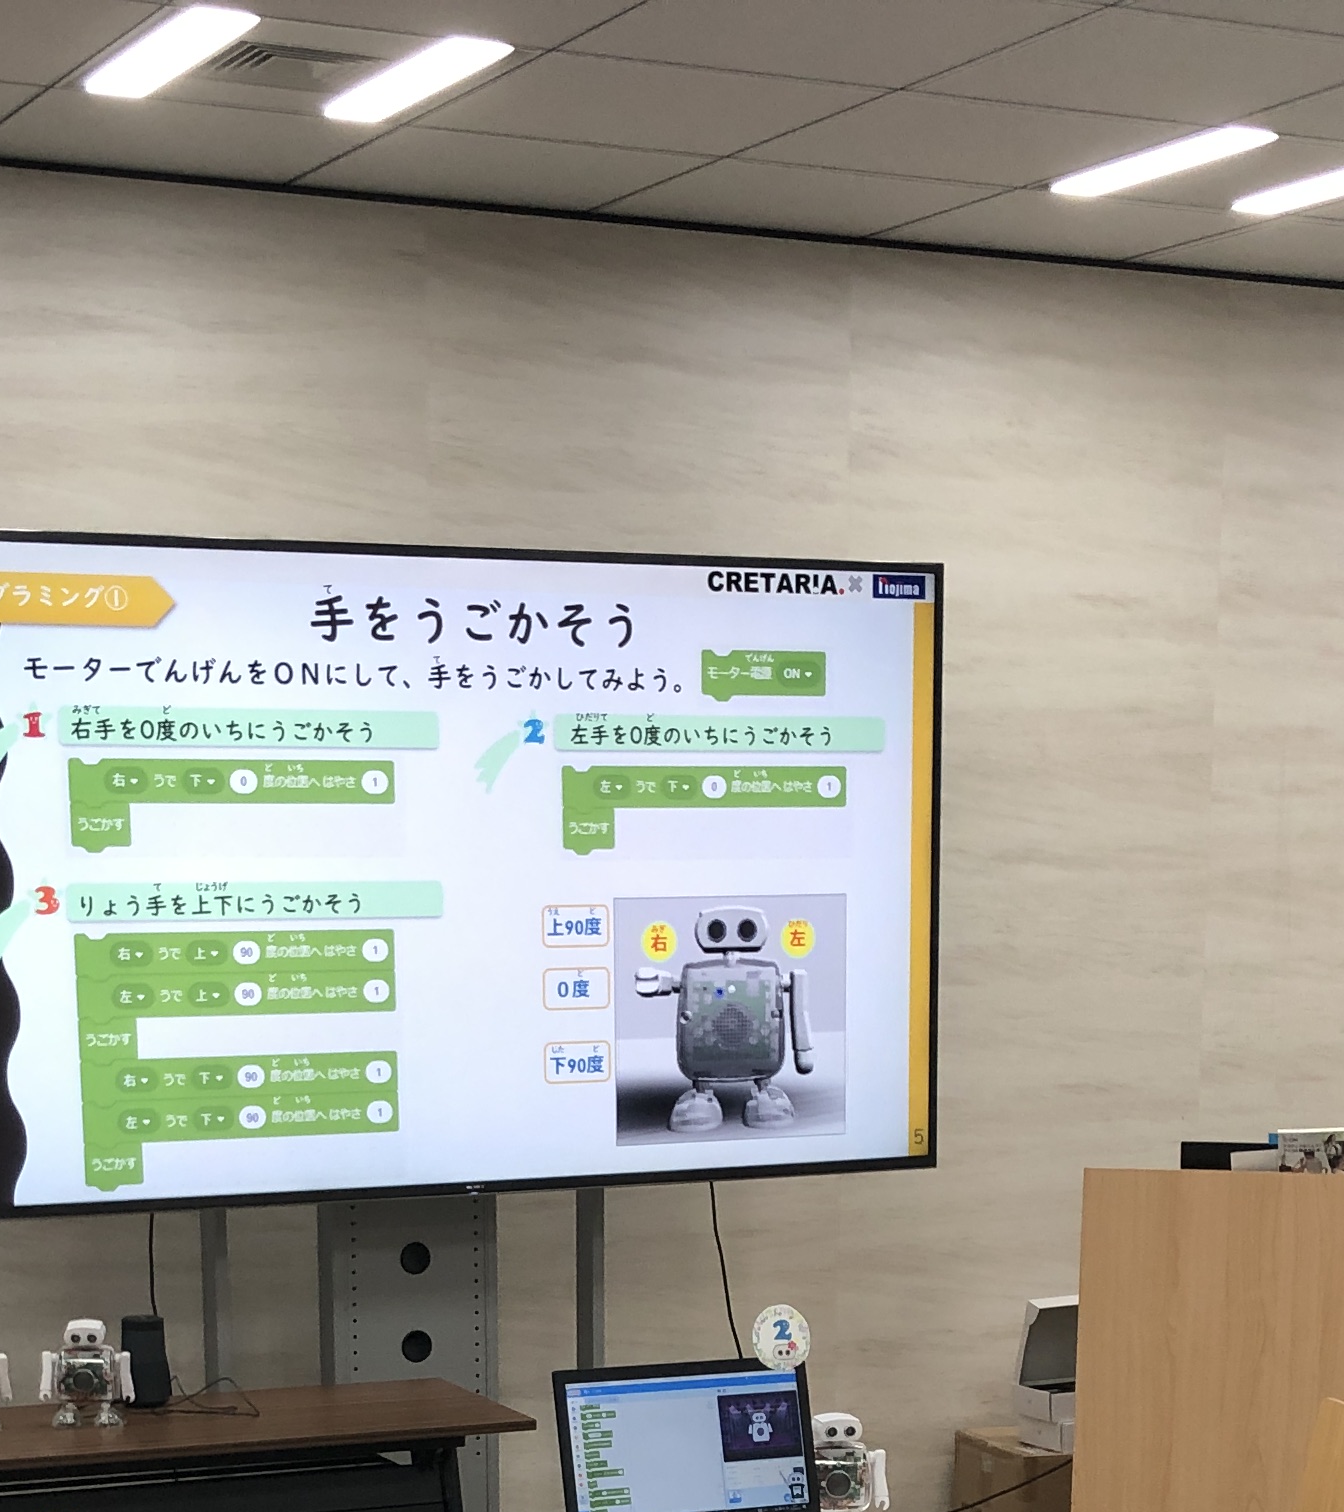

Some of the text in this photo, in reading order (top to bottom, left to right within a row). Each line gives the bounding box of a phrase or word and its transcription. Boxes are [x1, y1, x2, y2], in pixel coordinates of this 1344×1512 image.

[311, 595, 634, 648] 手をうごかそう
[783, 668, 801, 678] ON
[524, 719, 545, 745] 2
[112, 774, 125, 787] 右
[154, 775, 176, 787] うで
[190, 775, 201, 787] 下
[240, 777, 247, 786] 0
[600, 781, 611, 792] 左
[636, 782, 656, 792] うで
[668, 782, 677, 792] 下
[711, 783, 717, 791] 0
[34, 885, 60, 915] 3
[80, 894, 362, 917] りょう手を上下にうごかそう
[547, 918, 602, 936] 上90度
[651, 934, 667, 952] 右
[790, 929, 806, 947] 左
[118, 948, 131, 960] 右
[159, 948, 181, 960] うで
[194, 948, 206, 960] 上
[240, 948, 253, 957] 90
[120, 990, 132, 1003] 左
[161, 990, 182, 1002] うで
[196, 990, 208, 1001] 上
[242, 989, 254, 999] 90
[558, 980, 590, 998] 0度
[550, 1055, 604, 1075] 下90度
[124, 1074, 136, 1087] 右
[164, 1074, 186, 1086] うで
[200, 1072, 211, 1085] 下
[245, 1072, 258, 1081] 90
[126, 1116, 138, 1129] 左
[166, 1115, 188, 1127] うで
[201, 1114, 212, 1126] 下
[246, 1113, 259, 1123] 90
[914, 1128, 924, 1144] 5
[773, 1320, 792, 1340] 2
